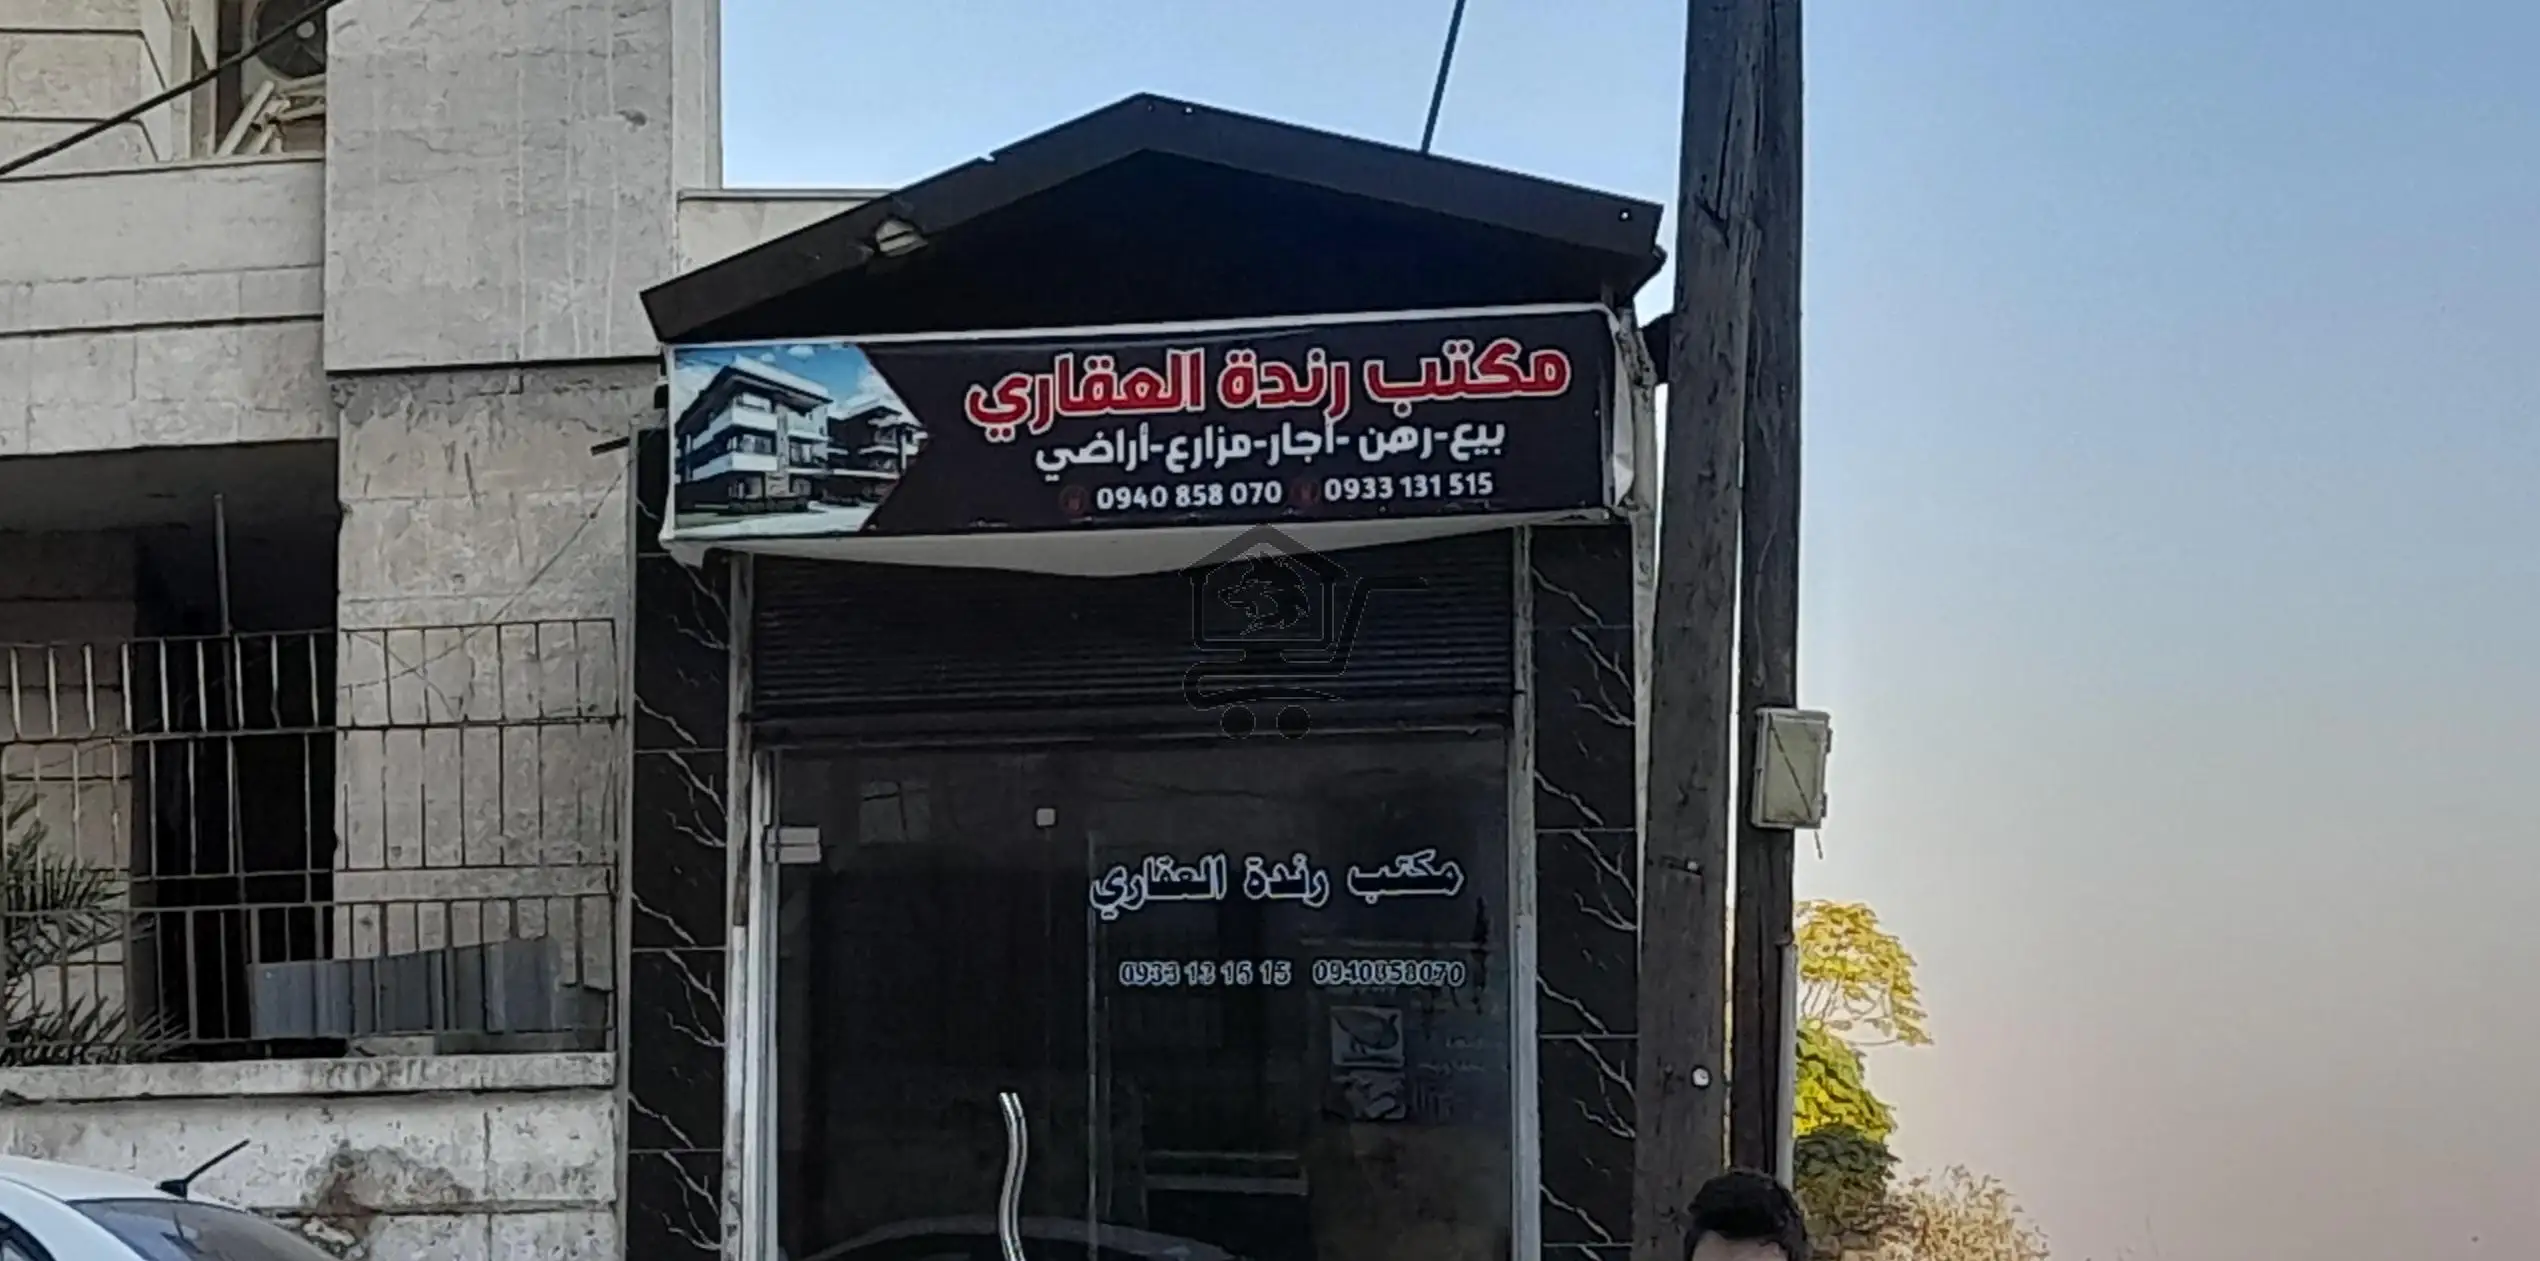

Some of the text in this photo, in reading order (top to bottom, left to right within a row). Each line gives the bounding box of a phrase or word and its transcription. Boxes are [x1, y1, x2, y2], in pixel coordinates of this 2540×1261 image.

[965, 338, 1571, 442] مكتب رندة العقاري
[1096, 480, 1283, 510] 0940 858 070
[1324, 471, 1494, 501] 0933 131 515
[1090, 849, 1464, 920] مكتب رندة العقاري
